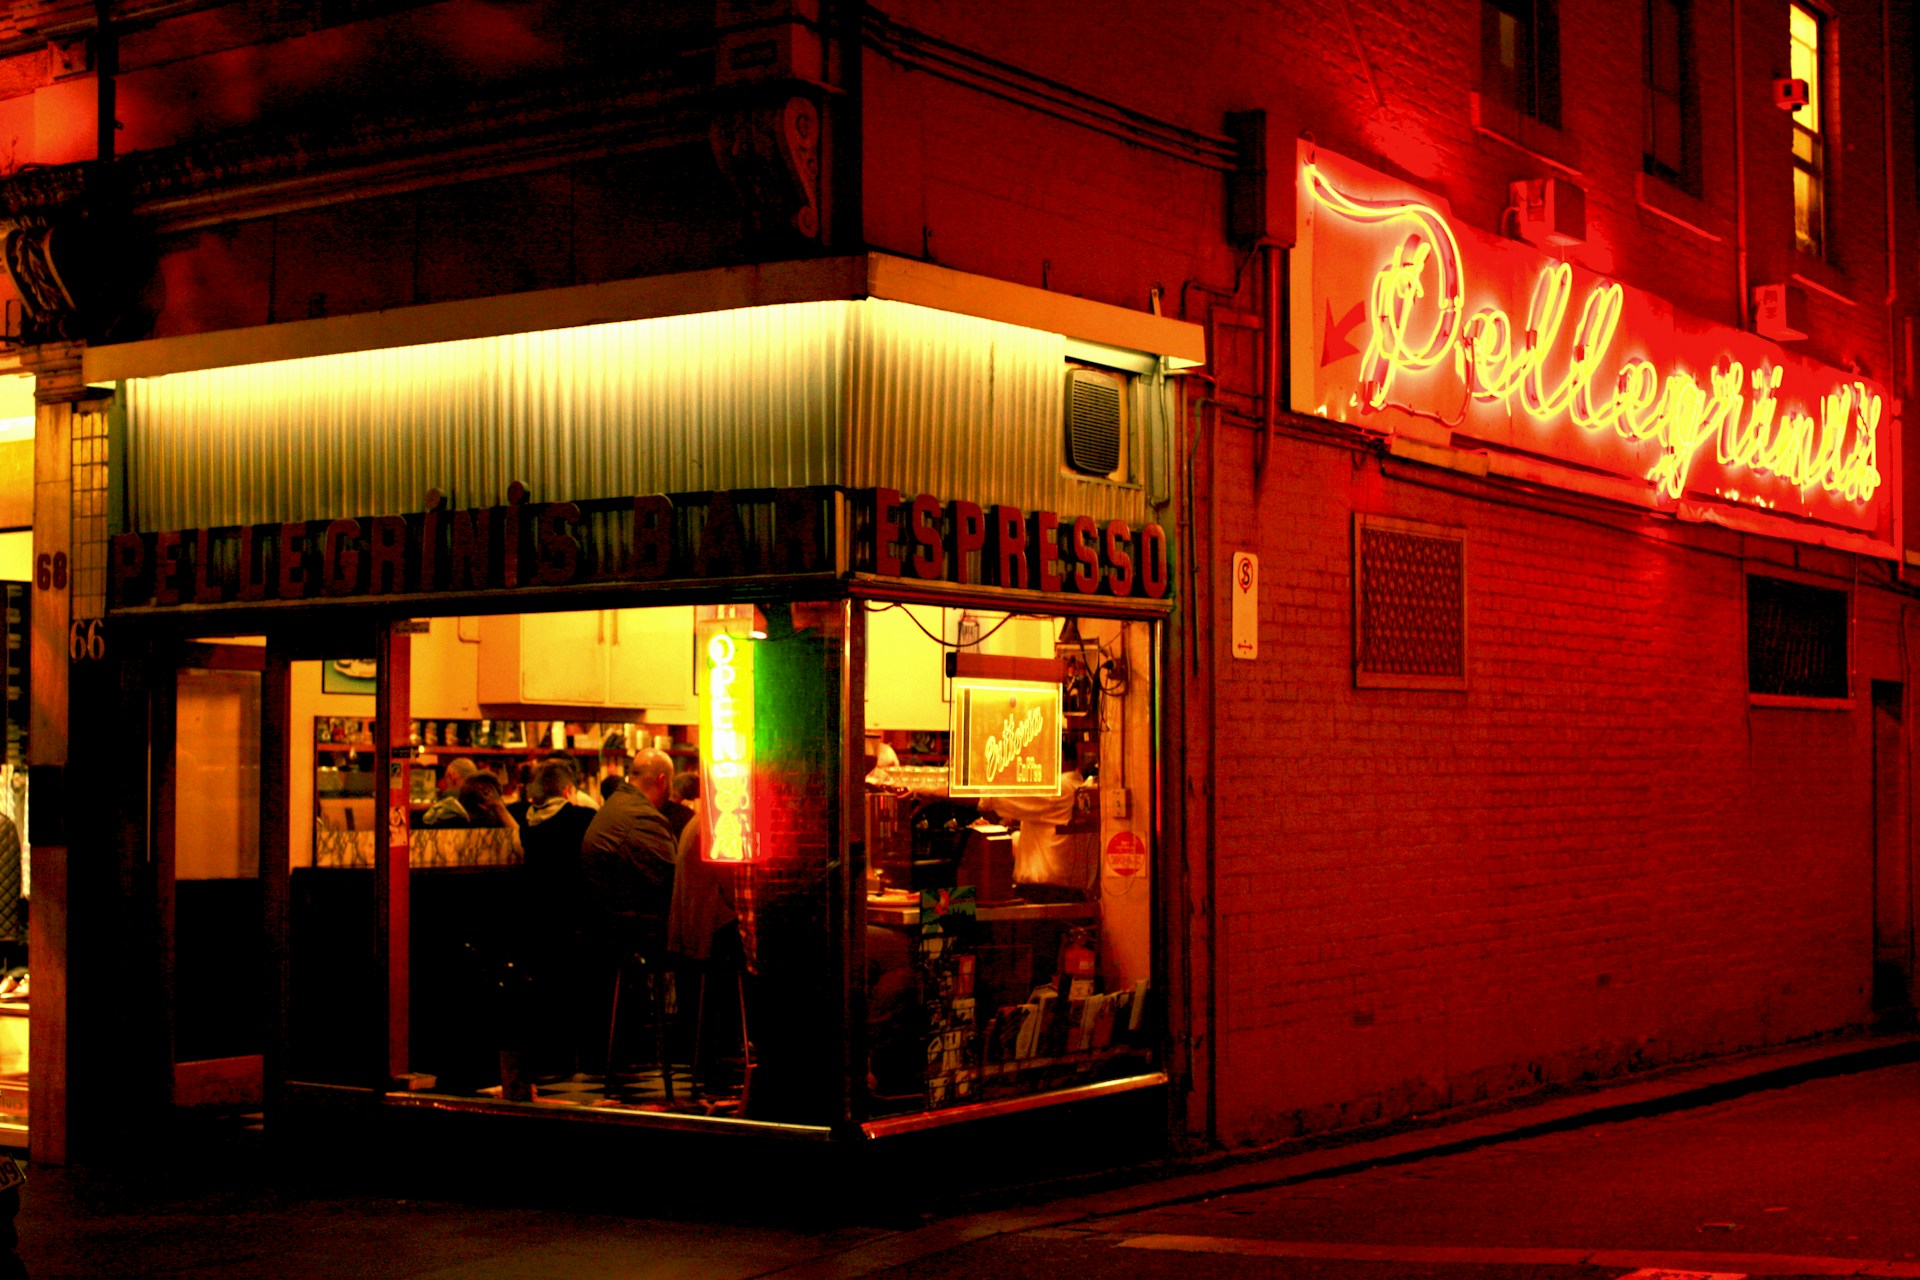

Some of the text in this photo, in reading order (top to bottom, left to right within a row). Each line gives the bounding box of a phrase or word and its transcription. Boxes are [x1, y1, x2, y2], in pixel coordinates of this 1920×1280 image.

[632, 486, 818, 580] BAR
[874, 486, 1168, 599] ESPRESSO
[37, 551, 67, 591] 68
[69, 619, 105, 662] 66
[709, 633, 739, 762] OPEN
[1016, 756, 1043, 783] Coffee
